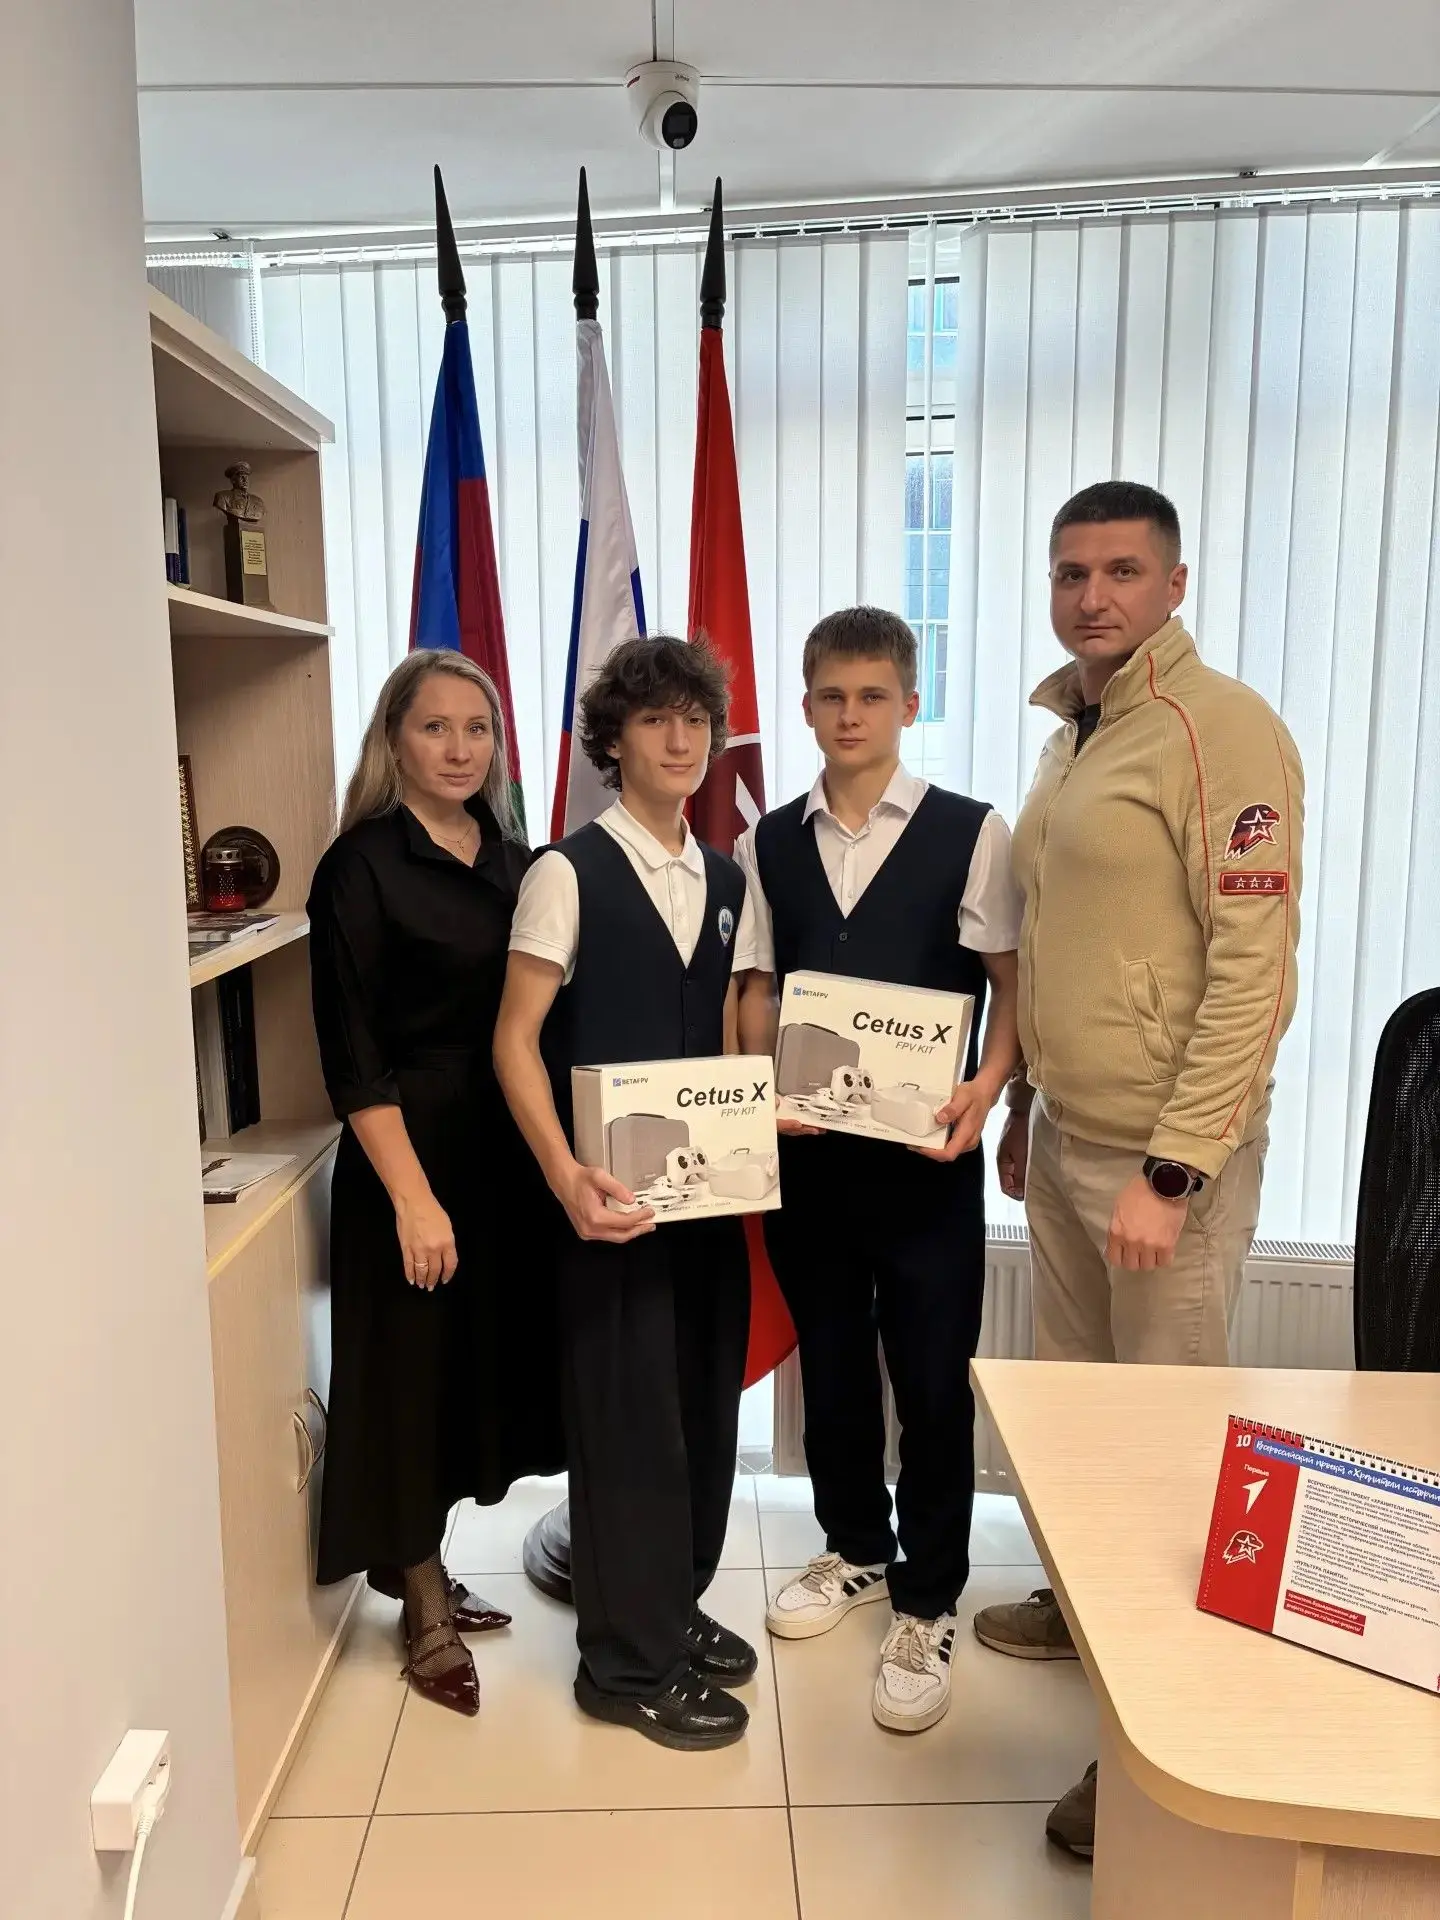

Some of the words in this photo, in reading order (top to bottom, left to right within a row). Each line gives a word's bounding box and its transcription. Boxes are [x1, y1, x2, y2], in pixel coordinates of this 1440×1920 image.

[802, 989, 829, 999] BETAFPV
[852, 1012, 924, 1040] Cetus
[930, 1024, 952, 1044] X
[895, 1041, 916, 1052] FPV
[917, 1044, 935, 1055] KIT
[622, 1077, 648, 1085] BETAFPV
[676, 1086, 744, 1108] Cetus
[751, 1082, 768, 1102] X
[720, 1108, 738, 1118] FPV
[740, 1106, 756, 1116] KIT
[1236, 1434, 1252, 1448] 10
[1244, 1464, 1270, 1476] Первые
[1256, 1440, 1314, 1465] Всероссийский
[1316, 1459, 1346, 1474] проект
[1348, 1468, 1400, 1490] «Хранители
